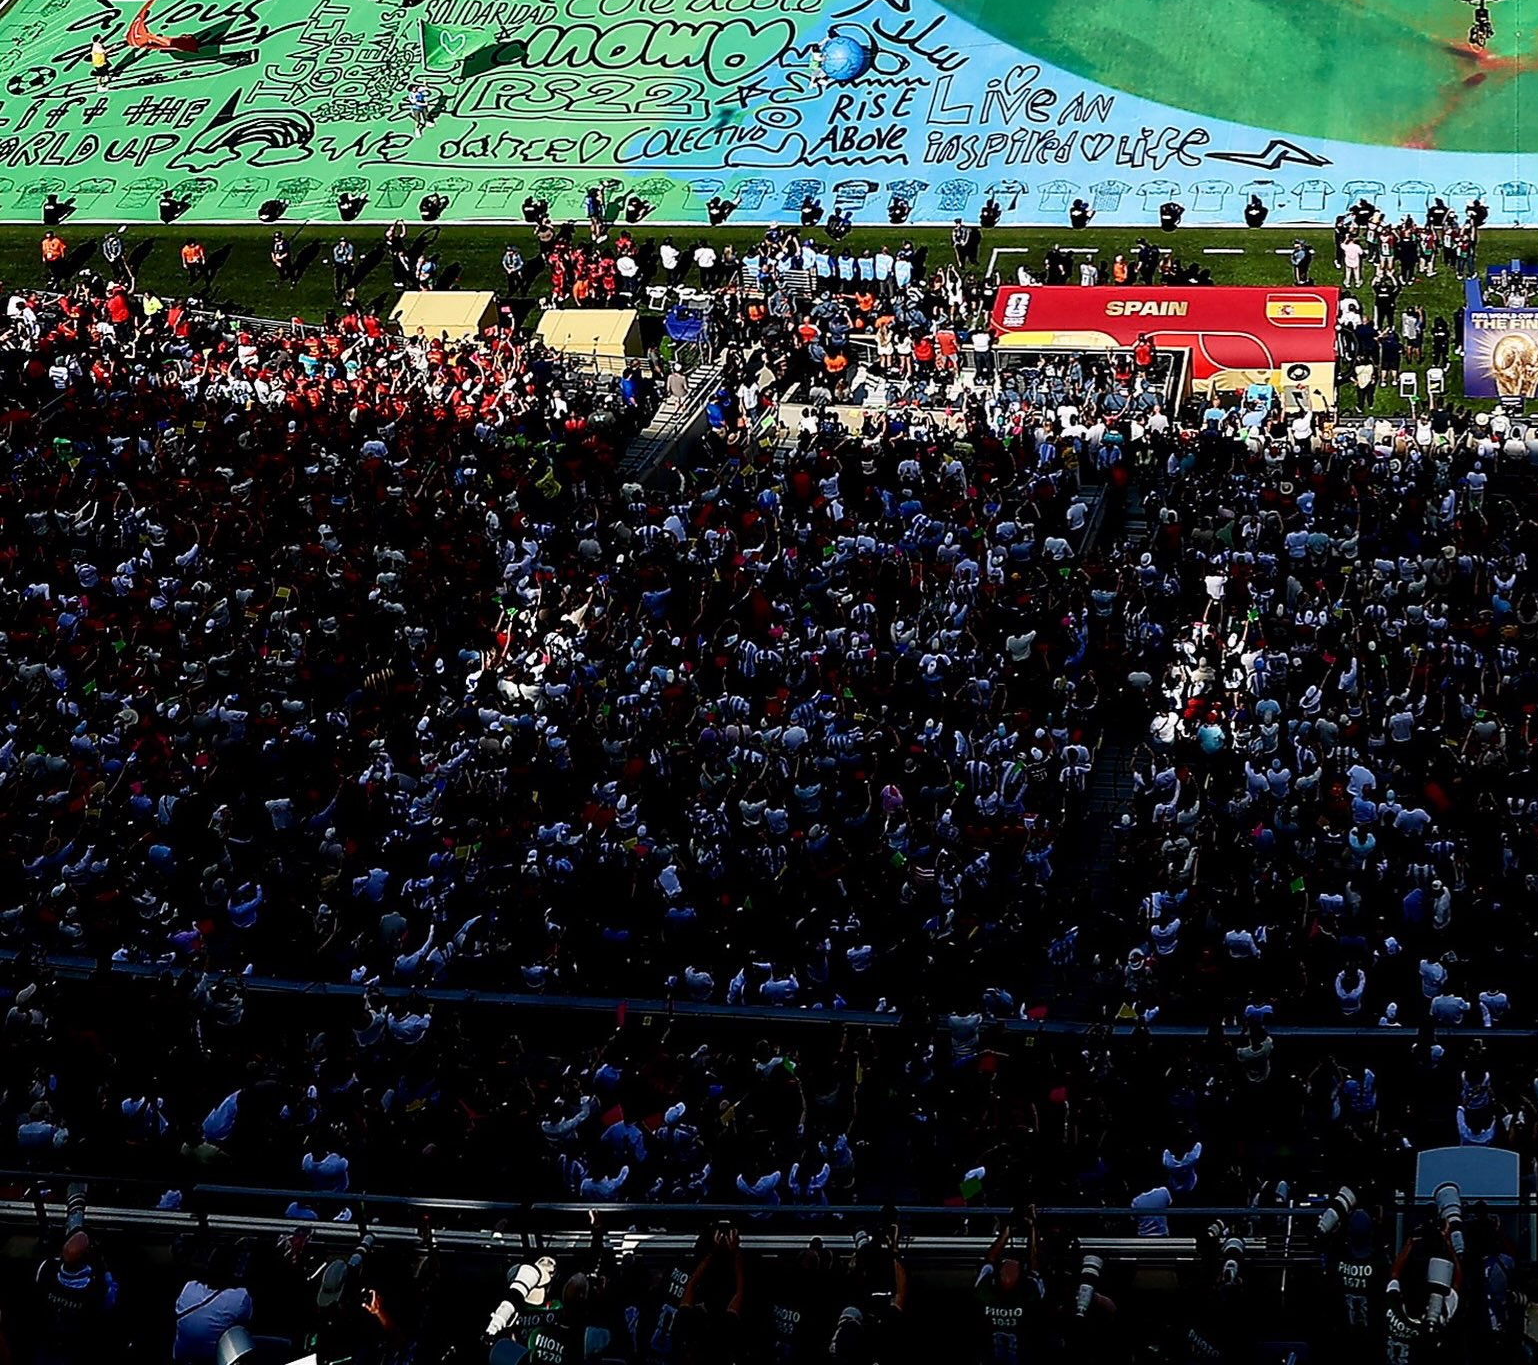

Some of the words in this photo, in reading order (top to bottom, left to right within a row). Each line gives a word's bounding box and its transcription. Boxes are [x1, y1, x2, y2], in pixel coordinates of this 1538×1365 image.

[1105, 301, 1189, 316] SPAIN
[1472, 319, 1507, 329] THE
[1337, 1261, 1374, 1278] PHOTO
[984, 1304, 1025, 1319] PHOTO
